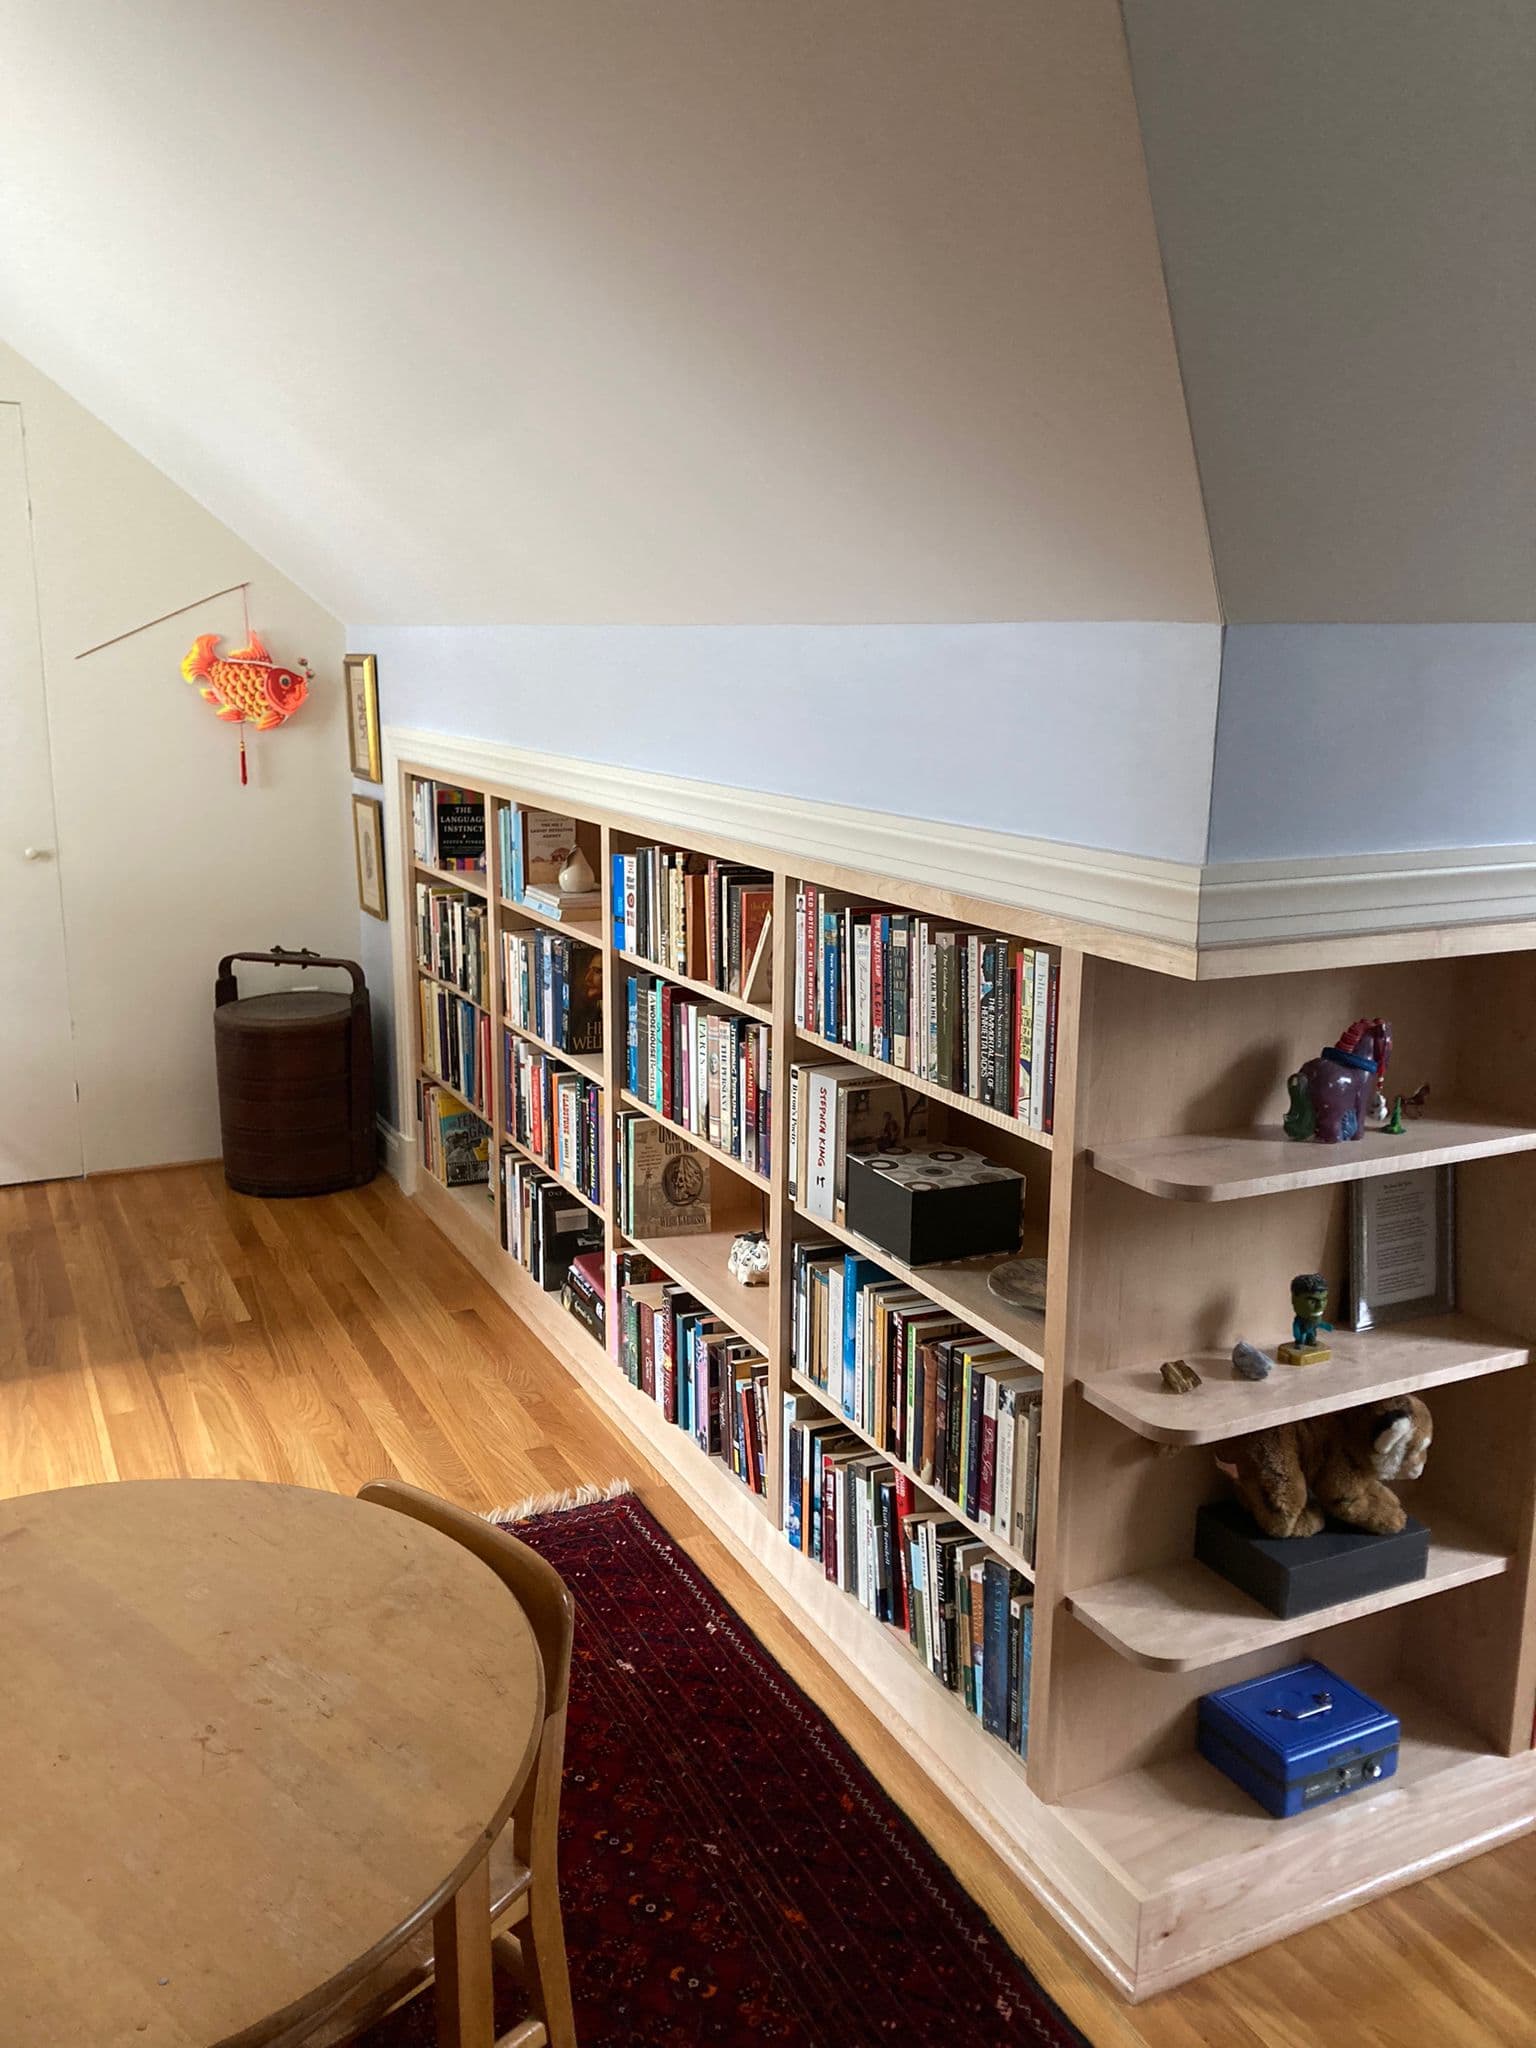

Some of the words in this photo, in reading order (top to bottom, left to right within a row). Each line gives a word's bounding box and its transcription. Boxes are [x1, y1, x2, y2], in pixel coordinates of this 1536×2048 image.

[455, 806, 472, 814] THE
[443, 825, 484, 833] INSTINCT
[807, 891, 815, 908] RED
[807, 910, 815, 939] NOTICE
[807, 951, 815, 969] BILL
[996, 947, 1006, 987] Running
[807, 971, 815, 1011] BROWDER
[930, 994, 937, 1003] IN
[997, 989, 1005, 1009] with
[1036, 974, 1045, 1007] blink
[874, 1000, 882, 1026] GILL
[981, 1006, 989, 1049] HENRIETTA
[699, 1023, 707, 1066] PARIS
[987, 1014, 995, 1059] IMMORTAL
[648, 1060, 656, 1098] Bestiary
[980, 1050, 988, 1078] LACKS
[818, 1087, 828, 1133] STEPHEN
[816, 1137, 826, 1168] KING
[883, 1530, 891, 1565] Rendell
[936, 1576, 945, 1601] Dahl
[994, 1599, 1002, 1633] BYATT
